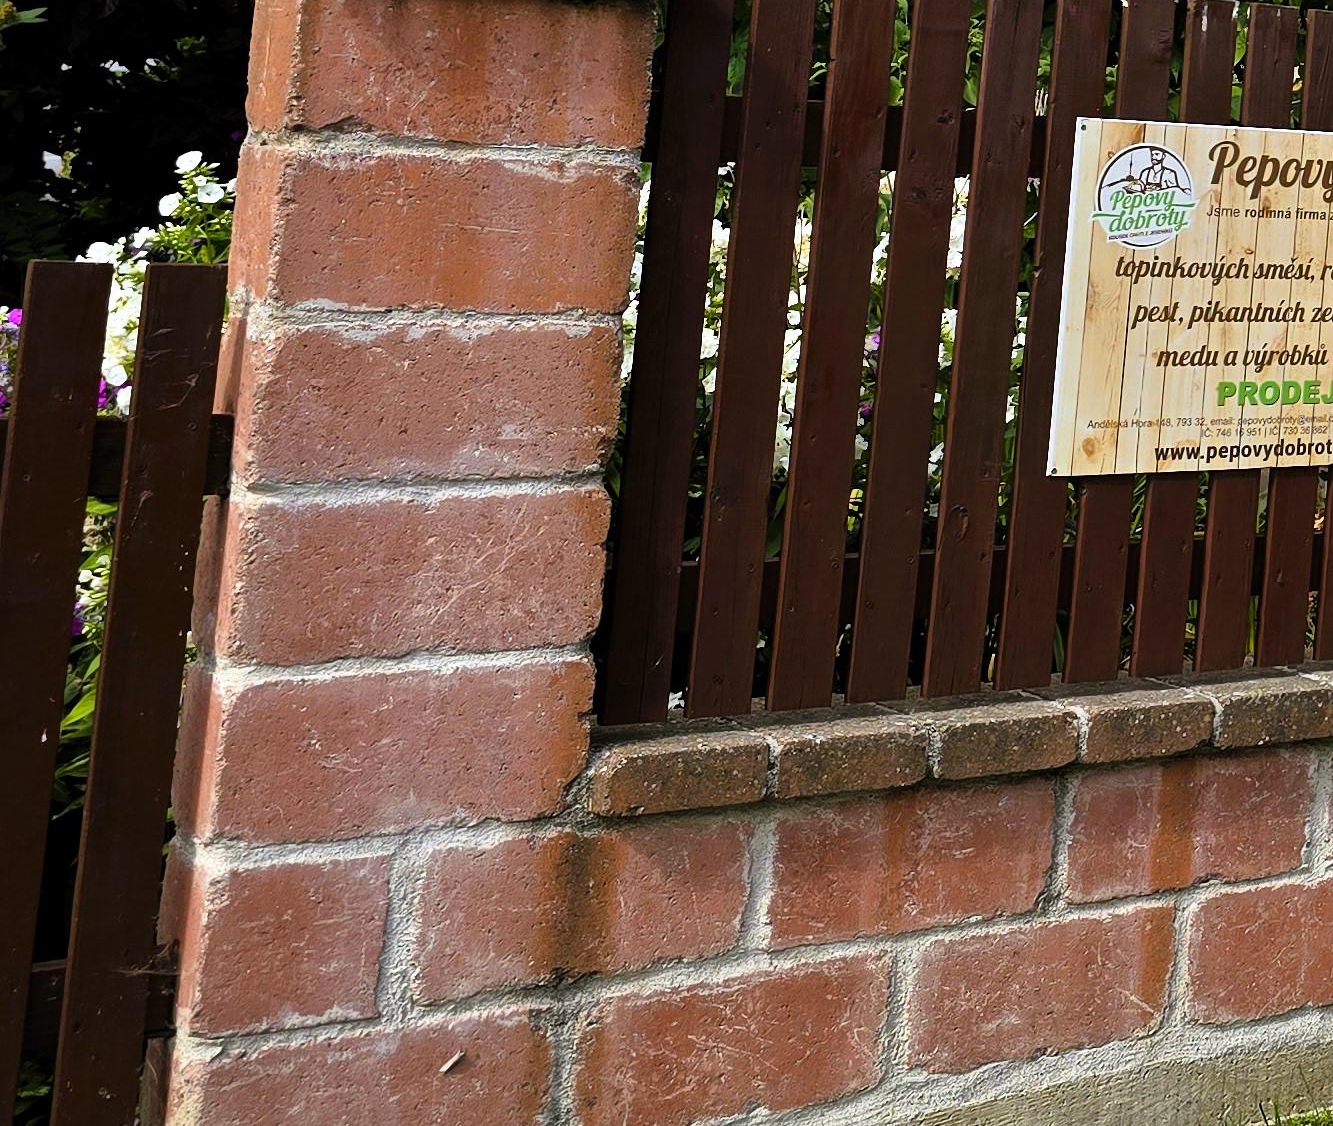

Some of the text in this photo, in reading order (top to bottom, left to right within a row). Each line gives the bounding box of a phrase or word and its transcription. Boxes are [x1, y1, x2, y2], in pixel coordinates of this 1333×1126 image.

[1110, 190, 1190, 215] Pepovy
[1207, 205, 1240, 218] Jsme
[1244, 206, 1291, 219] rodinná
[1295, 207, 1326, 221] firma
[1098, 208, 1189, 231] dobroty
[1115, 256, 1249, 286] topinkových
[1253, 256, 1315, 282] směsí,
[1131, 302, 1183, 329] pest,
[1187, 300, 1305, 329] pikantních
[1156, 345, 1218, 367] medu
[1224, 350, 1238, 366] a
[1243, 343, 1329, 373] výrobků
[1131, 418, 1152, 428] Hora
[1176, 418, 1192, 427] 793
[1216, 428, 1231, 437] 746
[1246, 427, 1261, 436] 951
[1283, 427, 1298, 435] 730
